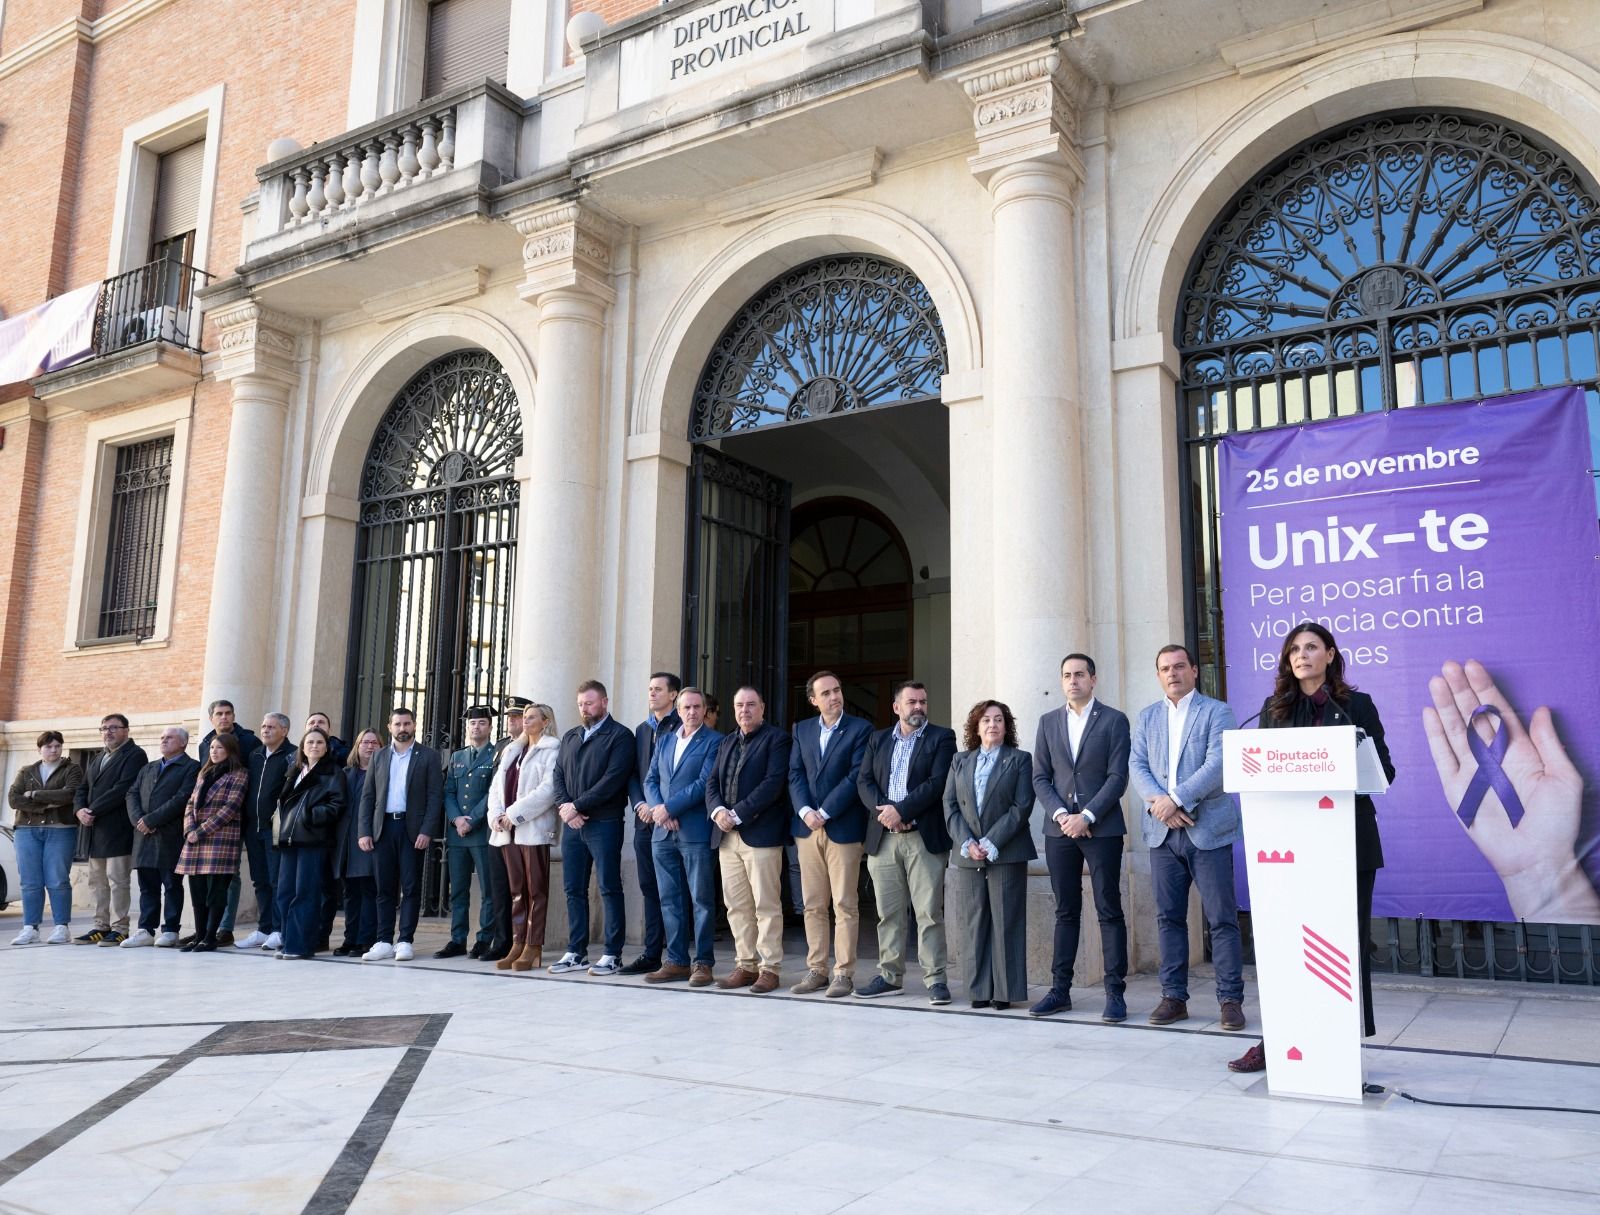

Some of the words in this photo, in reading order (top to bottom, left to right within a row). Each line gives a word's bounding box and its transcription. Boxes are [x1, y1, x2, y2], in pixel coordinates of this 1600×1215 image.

[670, 11, 811, 80] PROVINCIAL
[1246, 468, 1279, 493] 25
[1283, 464, 1320, 487] de
[1325, 446, 1480, 482] novembre
[1248, 509, 1490, 570] Unix-te
[1250, 583, 1295, 607] Per
[1300, 584, 1316, 602] a
[1321, 576, 1406, 606] posar
[1410, 568, 1430, 593] fi
[1436, 573, 1452, 592] a
[1459, 565, 1485, 590] la
[1382, 603, 1484, 630] contra
[1253, 647, 1282, 671] le
[1338, 645, 1389, 666] nes
[1266, 747, 1329, 762] Diputació
[1267, 763, 1283, 774] de
[1285, 760, 1336, 773] Castelló
